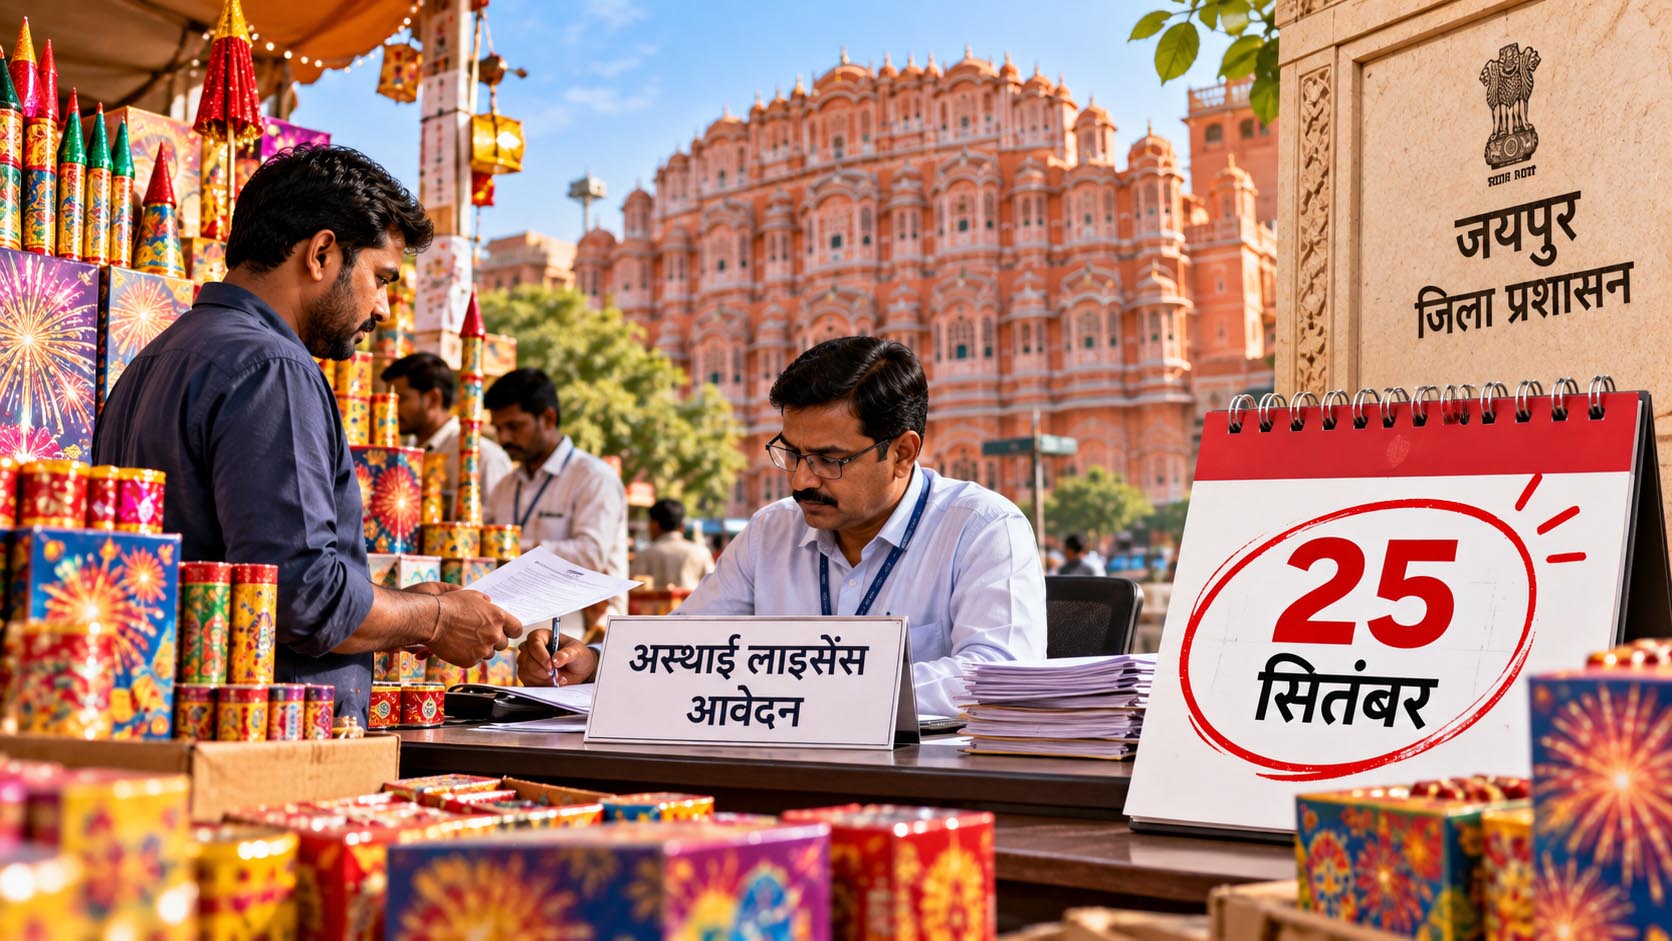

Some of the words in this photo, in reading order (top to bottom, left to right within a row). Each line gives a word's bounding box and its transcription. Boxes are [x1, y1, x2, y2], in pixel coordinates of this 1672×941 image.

[1454, 190, 1582, 267] जयपुर
[1414, 285, 1496, 339] जिला
[1504, 261, 1635, 324] प्रशासन
[1272, 537, 1458, 649] 25
[628, 634, 741, 681] अस्थाई
[747, 634, 870, 680] लाइसेंस
[1255, 652, 1439, 730] सितंबर
[686, 685, 805, 730] आवेदन
